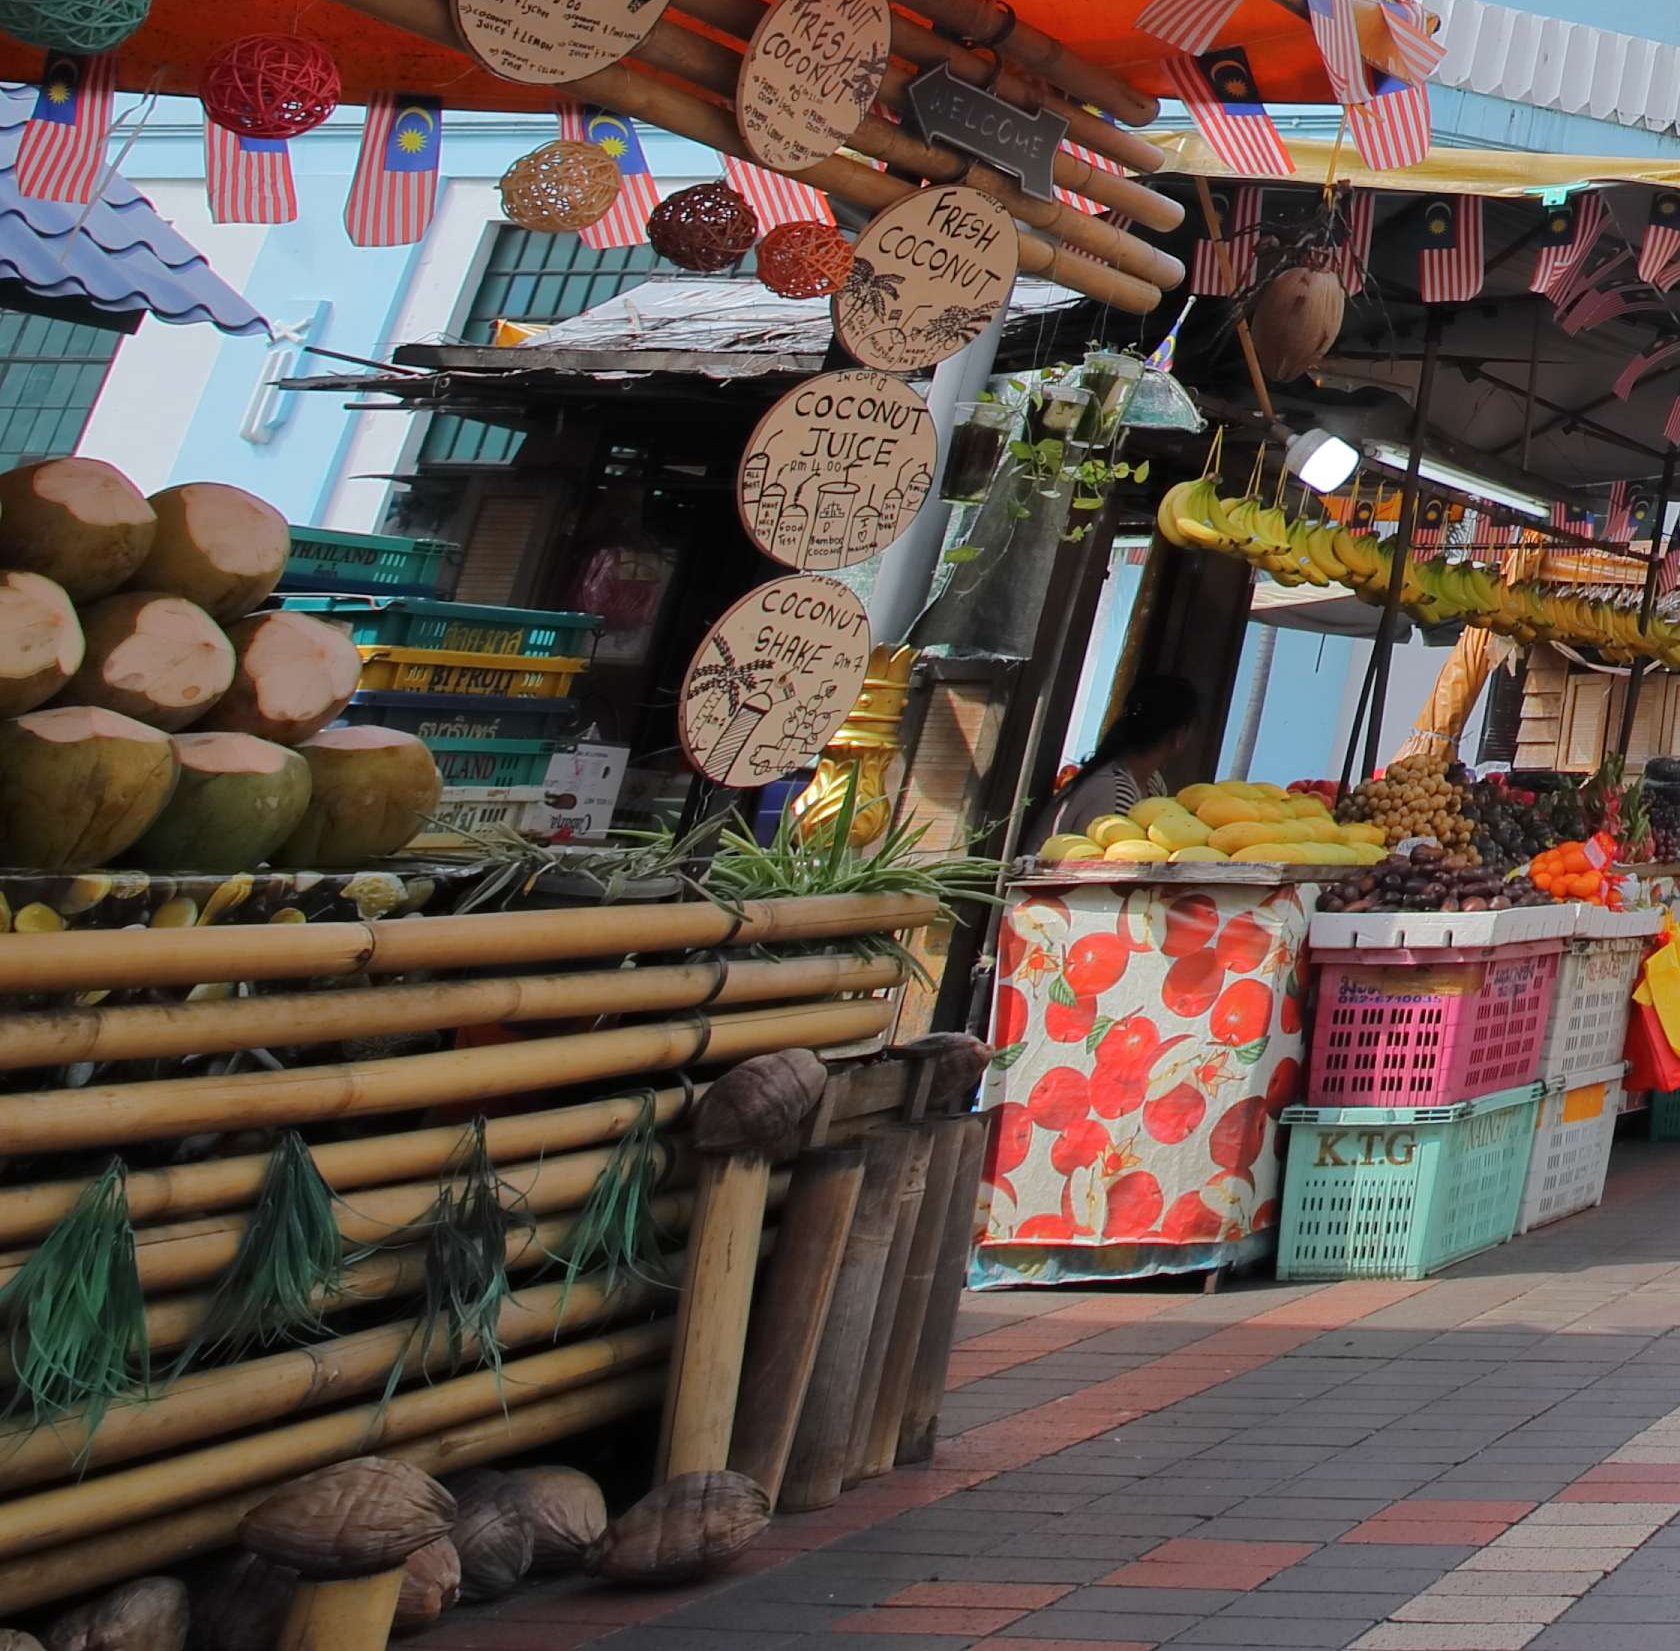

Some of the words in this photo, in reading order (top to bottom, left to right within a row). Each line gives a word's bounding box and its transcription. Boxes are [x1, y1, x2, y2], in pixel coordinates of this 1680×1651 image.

[792, 8, 862, 77] FRESH
[762, 33, 854, 105] COCONUT
[930, 87, 1045, 159] WELCOME
[928, 191, 1001, 253] FRESH
[878, 226, 1002, 300] COCONUT
[856, 373, 880, 386] CUP
[795, 391, 930, 435] COCONUT
[800, 428, 899, 466] JUICE
[811, 460, 843, 473] 4.00
[762, 589, 869, 637] COCONUT
[754, 626, 833, 674] SHAKE
[455, 669, 516, 689] FRUIT
[440, 755, 497, 781] ILAND
